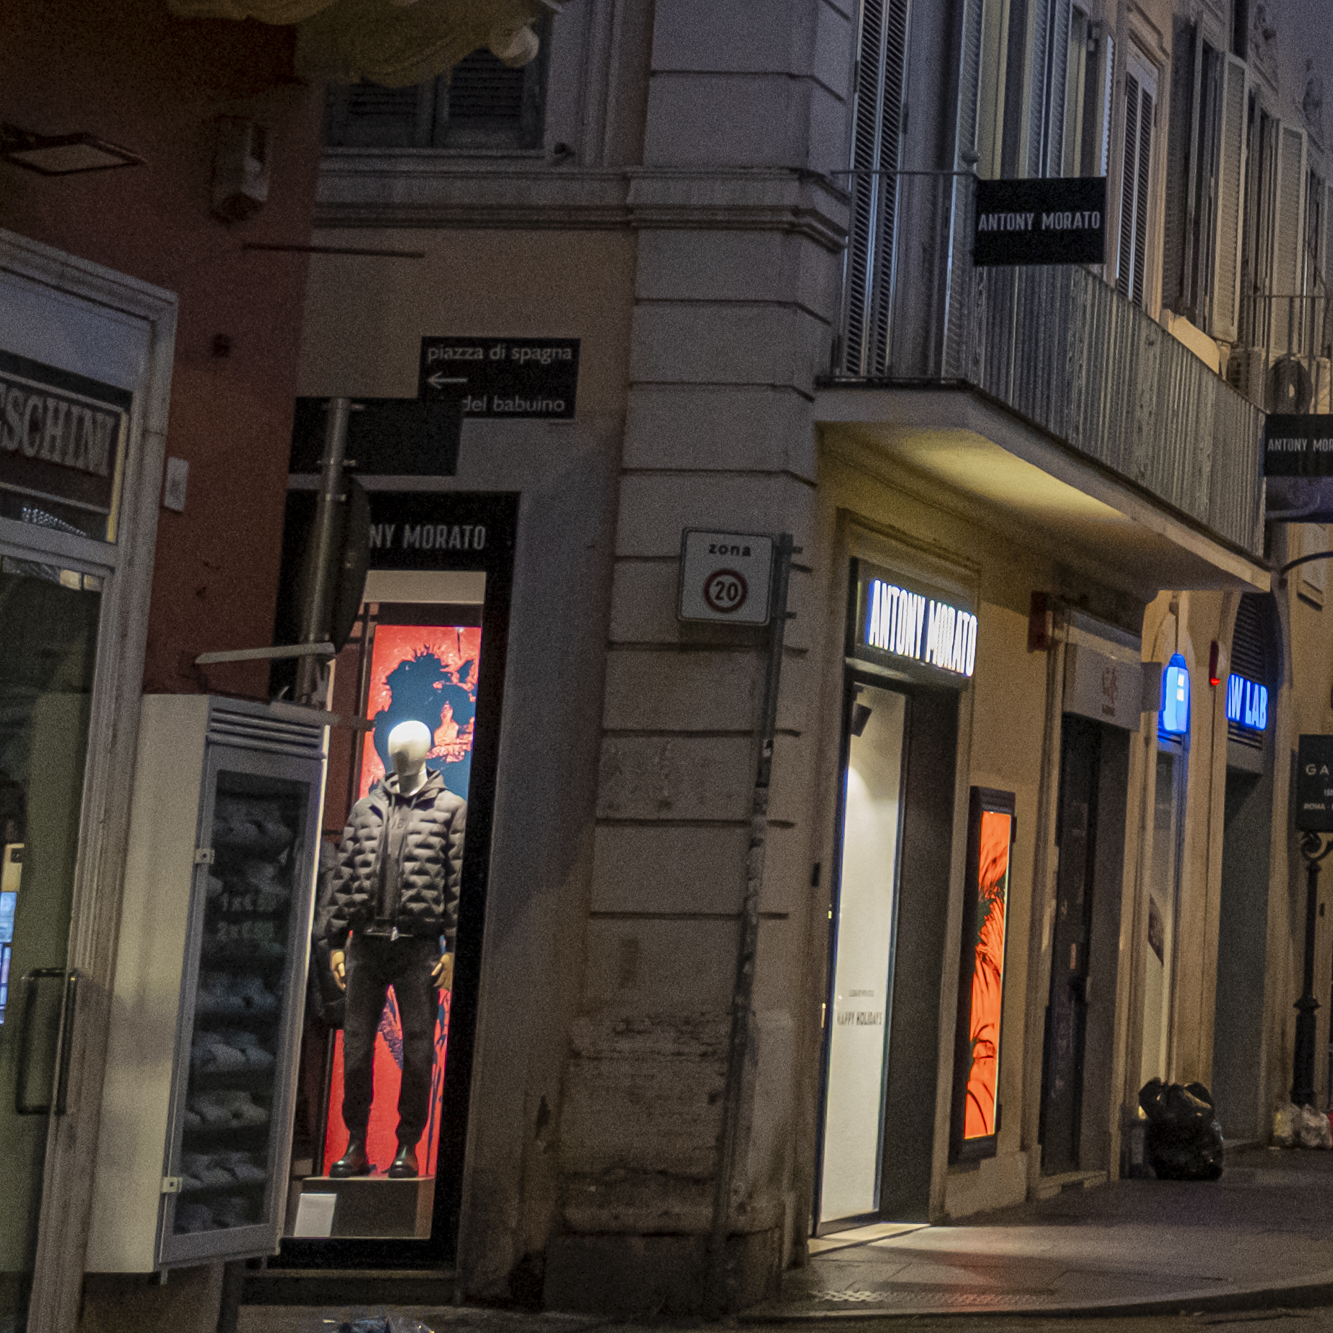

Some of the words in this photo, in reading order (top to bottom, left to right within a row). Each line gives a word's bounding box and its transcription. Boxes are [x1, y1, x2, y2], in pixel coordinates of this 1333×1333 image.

[977, 212, 1035, 231] ANTONY
[1041, 211, 1101, 230] MORATO
[427, 344, 484, 365] piazza
[489, 343, 506, 360] di
[511, 346, 573, 365] spagna
[493, 395, 566, 412] babuino
[1267, 438, 1308, 452] ANTONY
[402, 524, 487, 550] MORATO
[709, 544, 751, 556] zona
[715, 581, 738, 601] 20
[868, 579, 926, 661] ANTONY
[925, 599, 978, 677] MORATO
[1245, 681, 1268, 730] LAB
